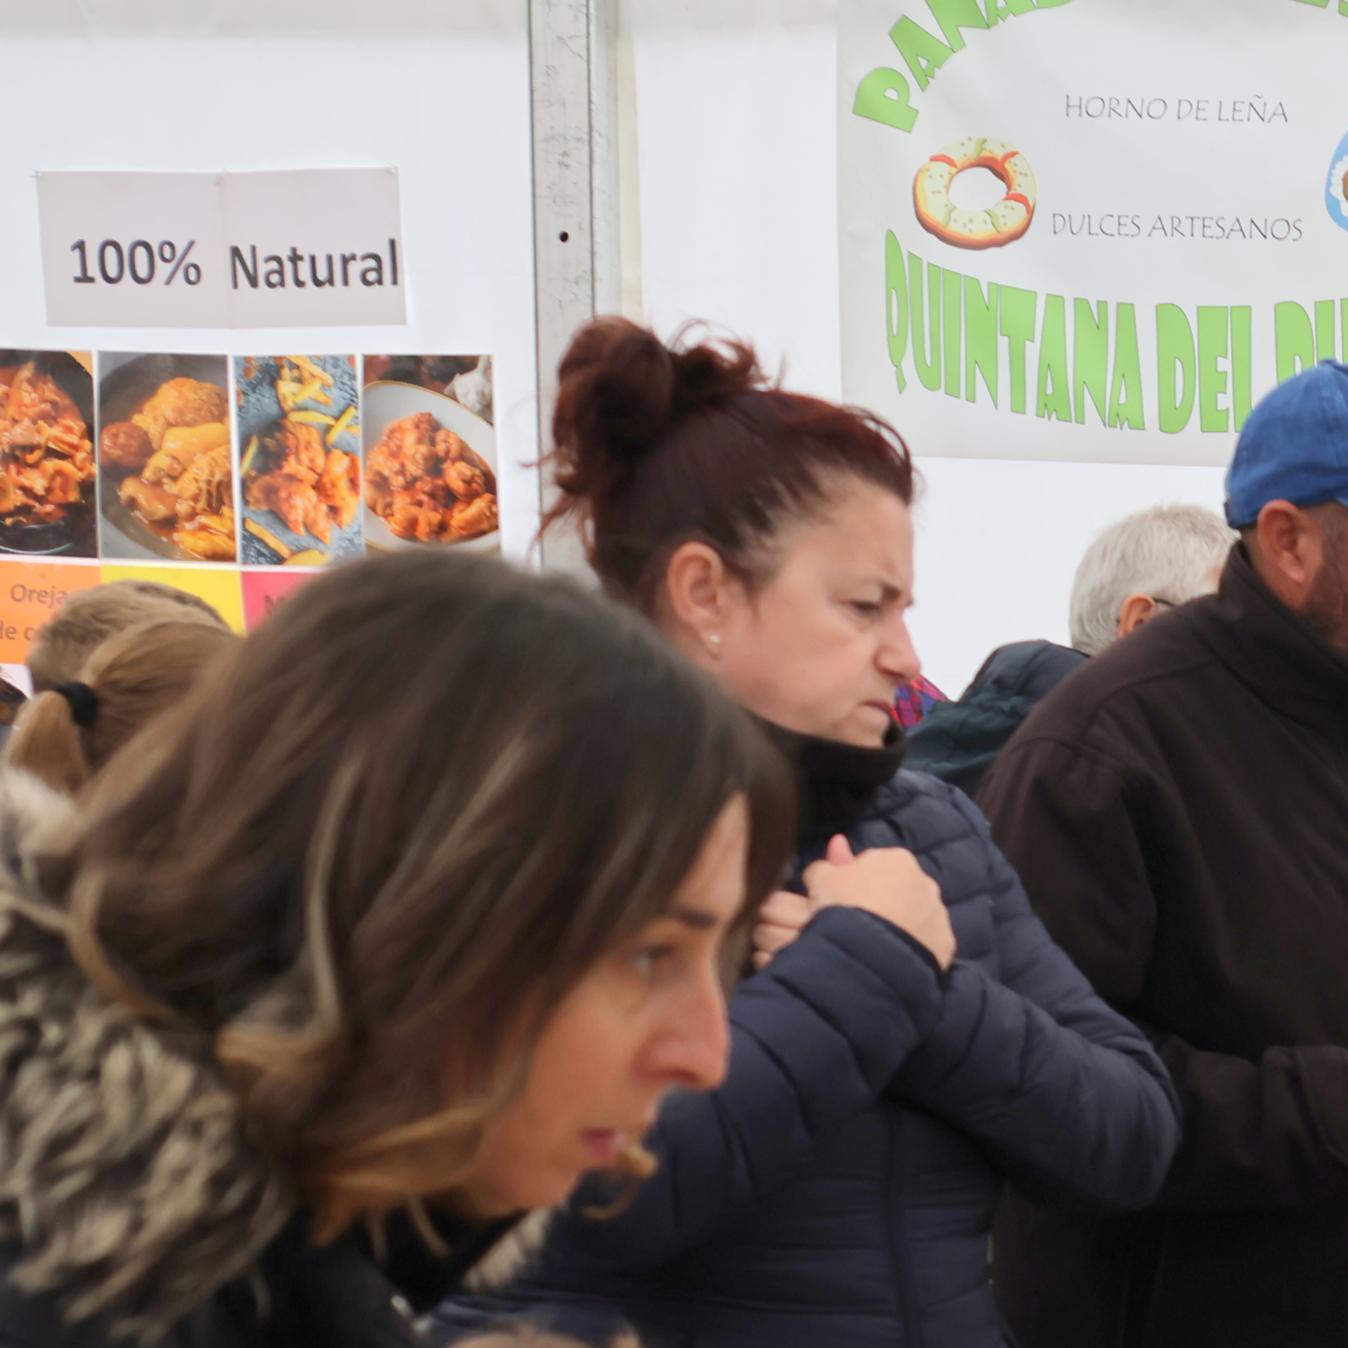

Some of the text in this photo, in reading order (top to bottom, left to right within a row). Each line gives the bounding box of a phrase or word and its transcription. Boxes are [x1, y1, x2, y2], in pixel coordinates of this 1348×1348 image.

[1065, 94, 1289, 124] HORNO DE LEÑA
[1051, 212, 1303, 243] DULCES ARTESANOS
[70, 237, 399, 290] 100% Natural
[885, 229, 1146, 432] QUINTANA
